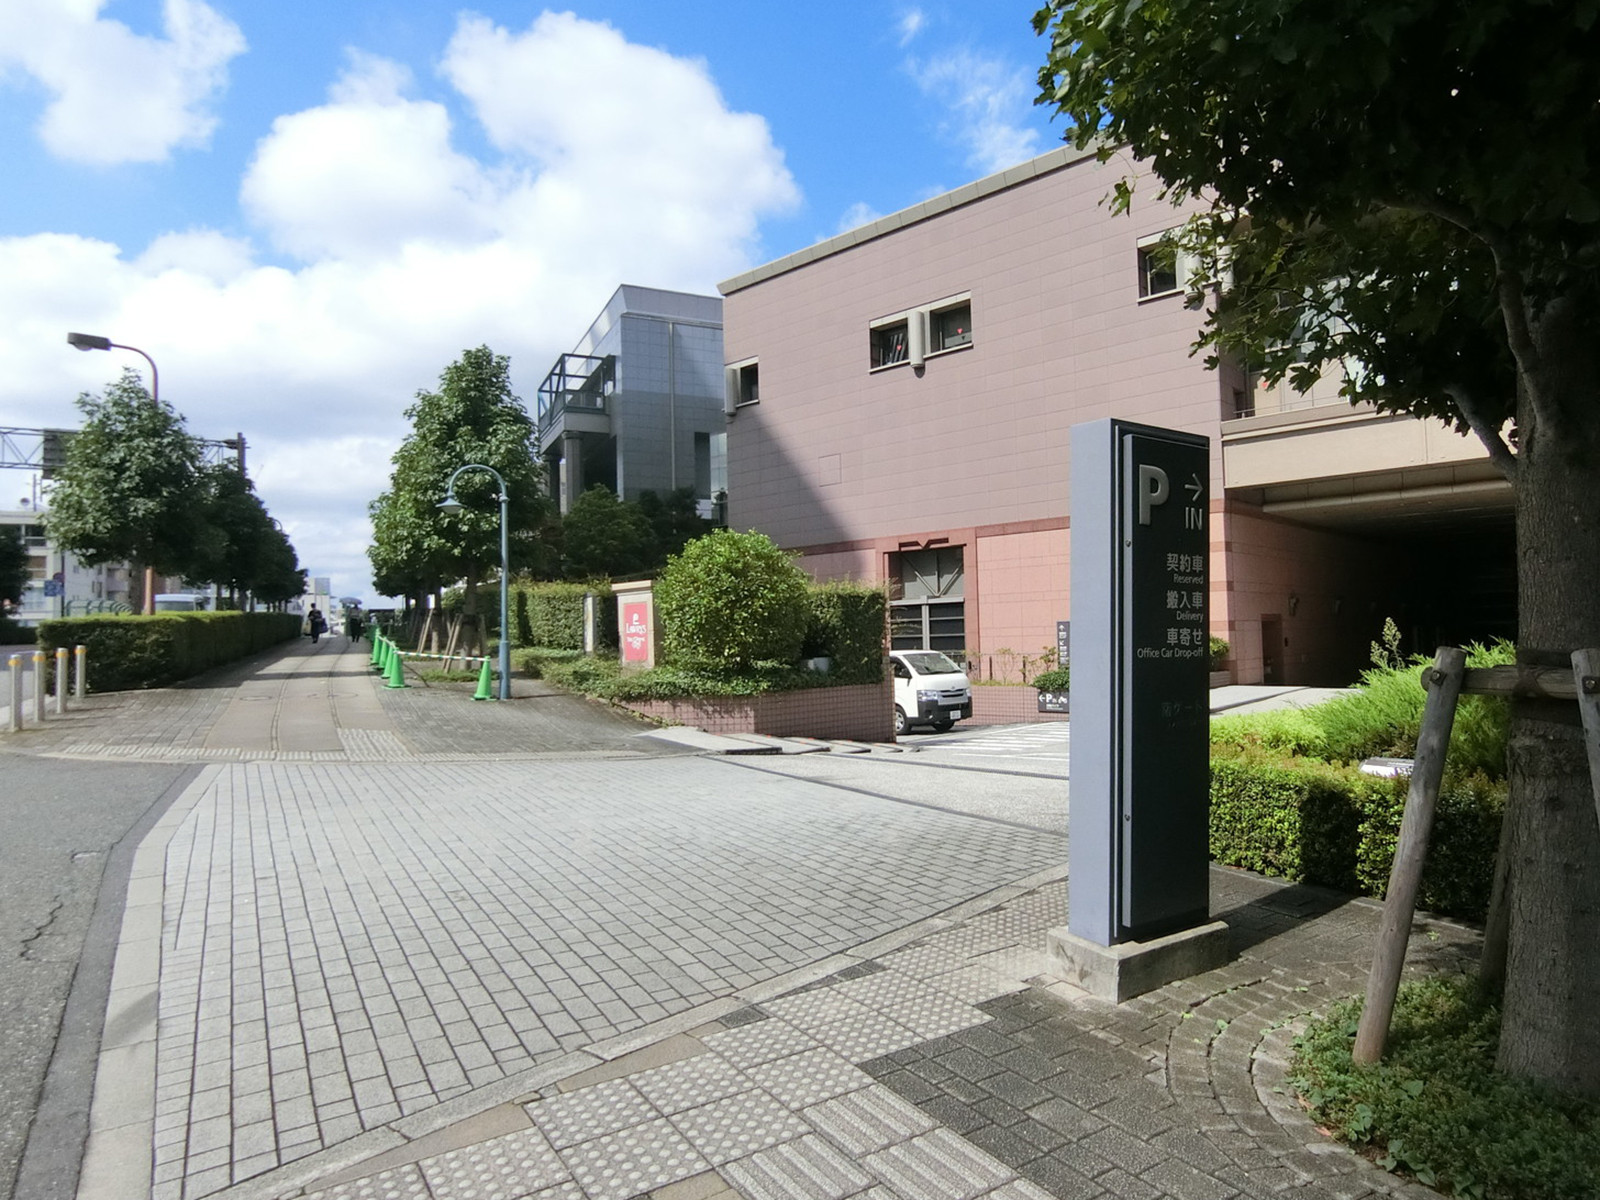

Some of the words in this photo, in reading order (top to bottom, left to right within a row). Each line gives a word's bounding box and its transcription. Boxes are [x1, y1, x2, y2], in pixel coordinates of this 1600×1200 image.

[1138, 463, 1170, 526] P
[1185, 506, 1203, 531] IN
[1166, 552, 1204, 573] 契約車
[1173, 573, 1204, 585] Reserved
[1166, 590, 1204, 609] 搬入車
[1176, 610, 1204, 623] Delivery
[1166, 627, 1203, 646] 車寄せ
[1136, 647, 1160, 658] Office
[1161, 648, 1173, 658] Car
[1174, 646, 1204, 659] Drop-off
[1045, 693, 1053, 703] P
